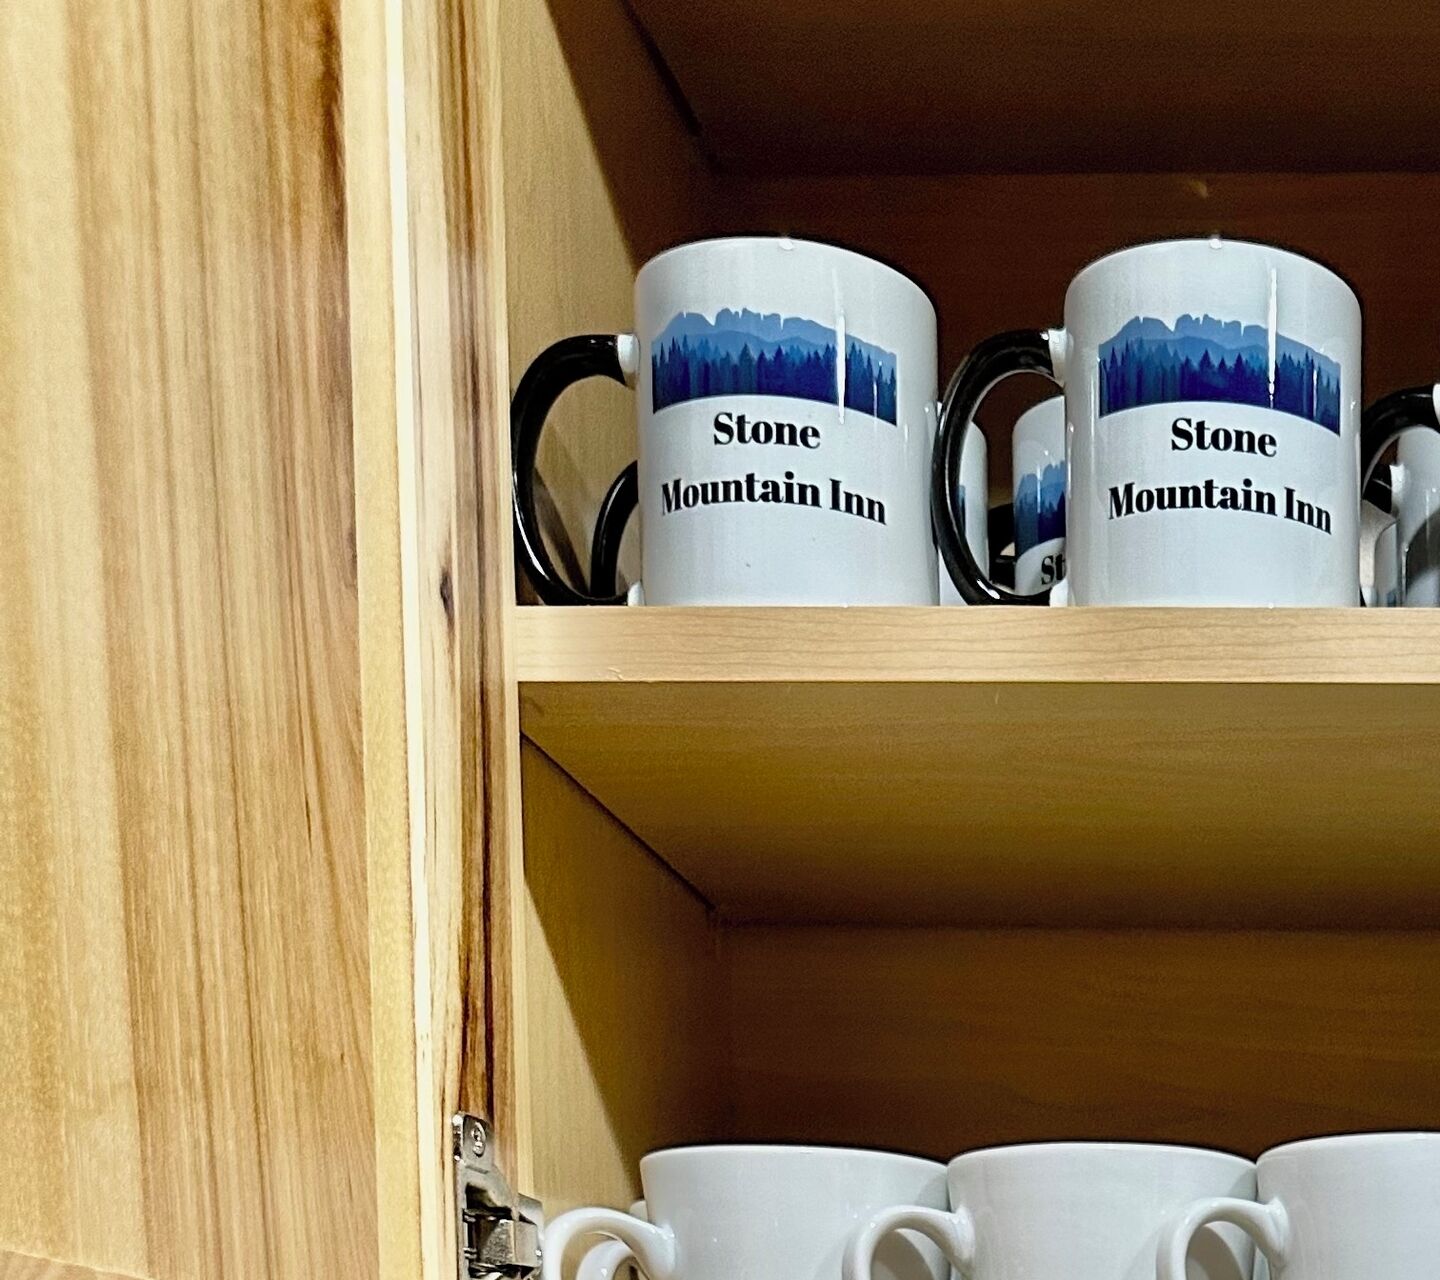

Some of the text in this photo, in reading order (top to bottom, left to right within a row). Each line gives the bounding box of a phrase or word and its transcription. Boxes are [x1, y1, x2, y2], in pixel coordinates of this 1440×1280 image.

[712, 411, 821, 450] Stone
[1169, 416, 1279, 458] Stone
[661, 473, 888, 526] Mountain Inn
[1108, 478, 1333, 536] Mountain Inn
